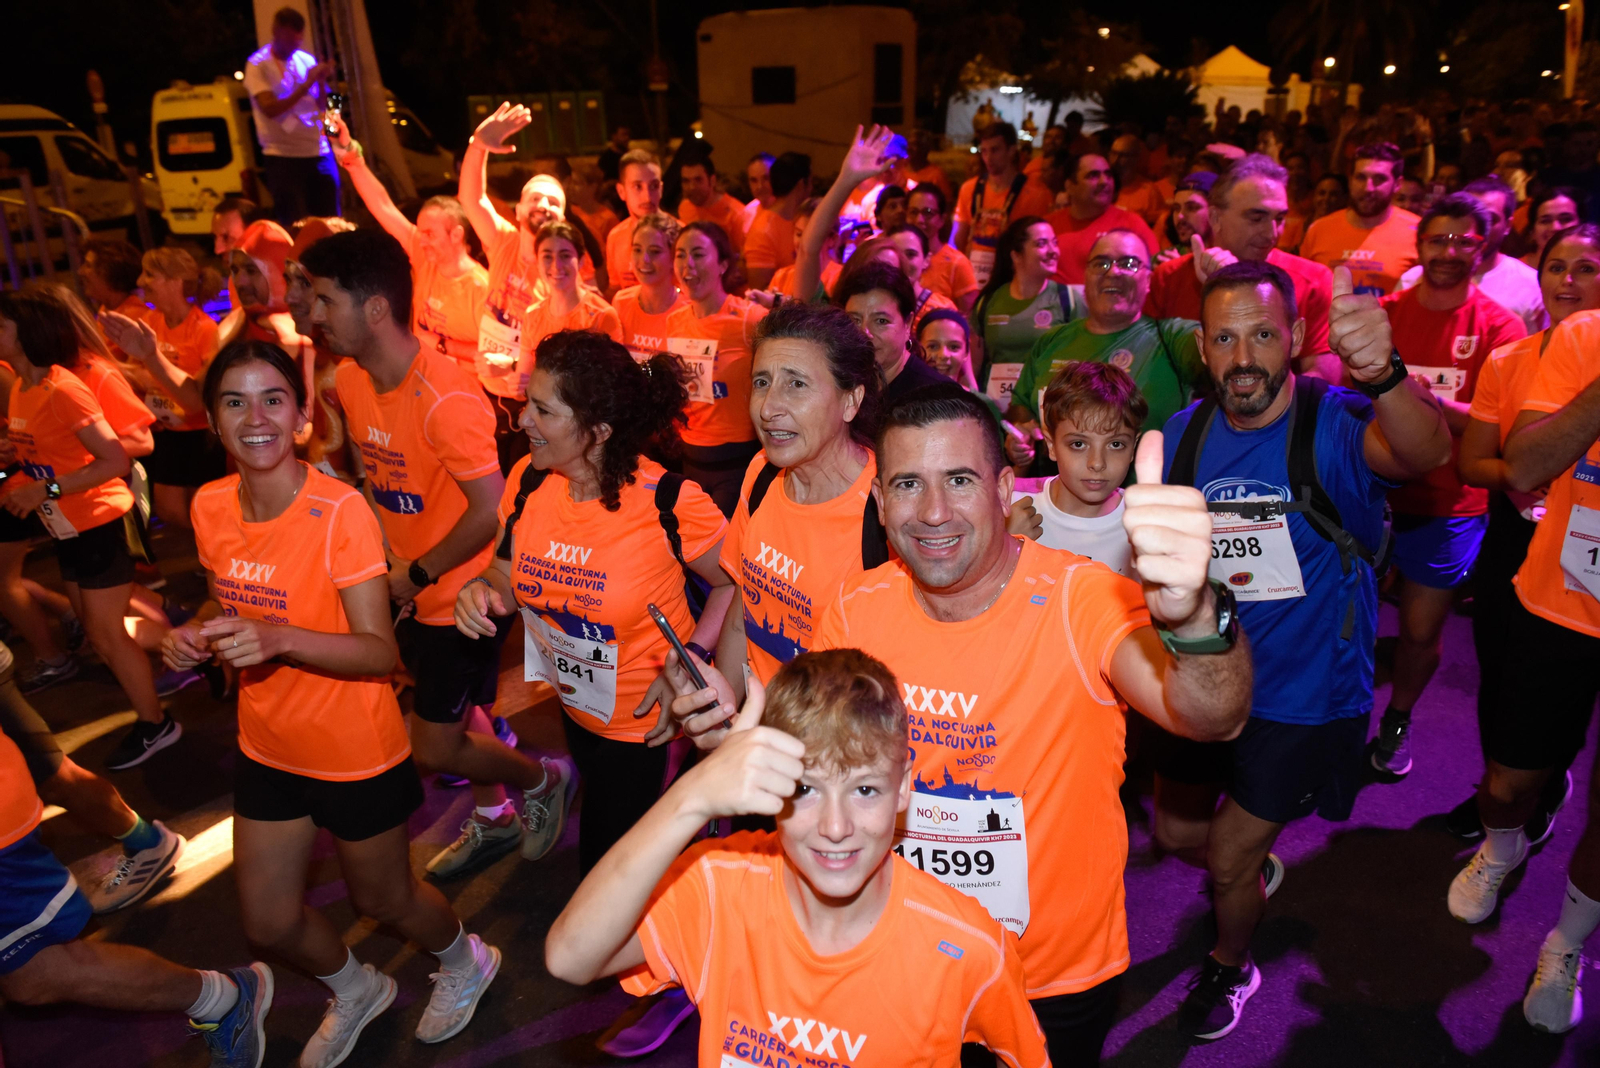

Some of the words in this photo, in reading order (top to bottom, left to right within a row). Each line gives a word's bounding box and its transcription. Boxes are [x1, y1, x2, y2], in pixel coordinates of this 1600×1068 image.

[633, 334, 662, 348] XXXV
[1000, 383, 1013, 393] 54
[544, 540, 593, 566] XXXV
[755, 541, 804, 584] XXXV
[227, 558, 276, 584] XXXV
[520, 553, 556, 570] CARRERA
[559, 564, 607, 580] NOCTURNA
[522, 564, 605, 592] GUADALQUIVIR
[244, 584, 287, 598] NOCTURNA
[770, 576, 812, 607] NOCTURNA
[1267, 585, 1299, 594] Cruzcampo
[903, 683, 978, 719] XXXV
[907, 831, 936, 840] NOCTURNA
[2, 933, 44, 961] KELME
[723, 1036, 735, 1052] DEL
[729, 1020, 798, 1060] CARRERA
[767, 1010, 867, 1062] XXXV
